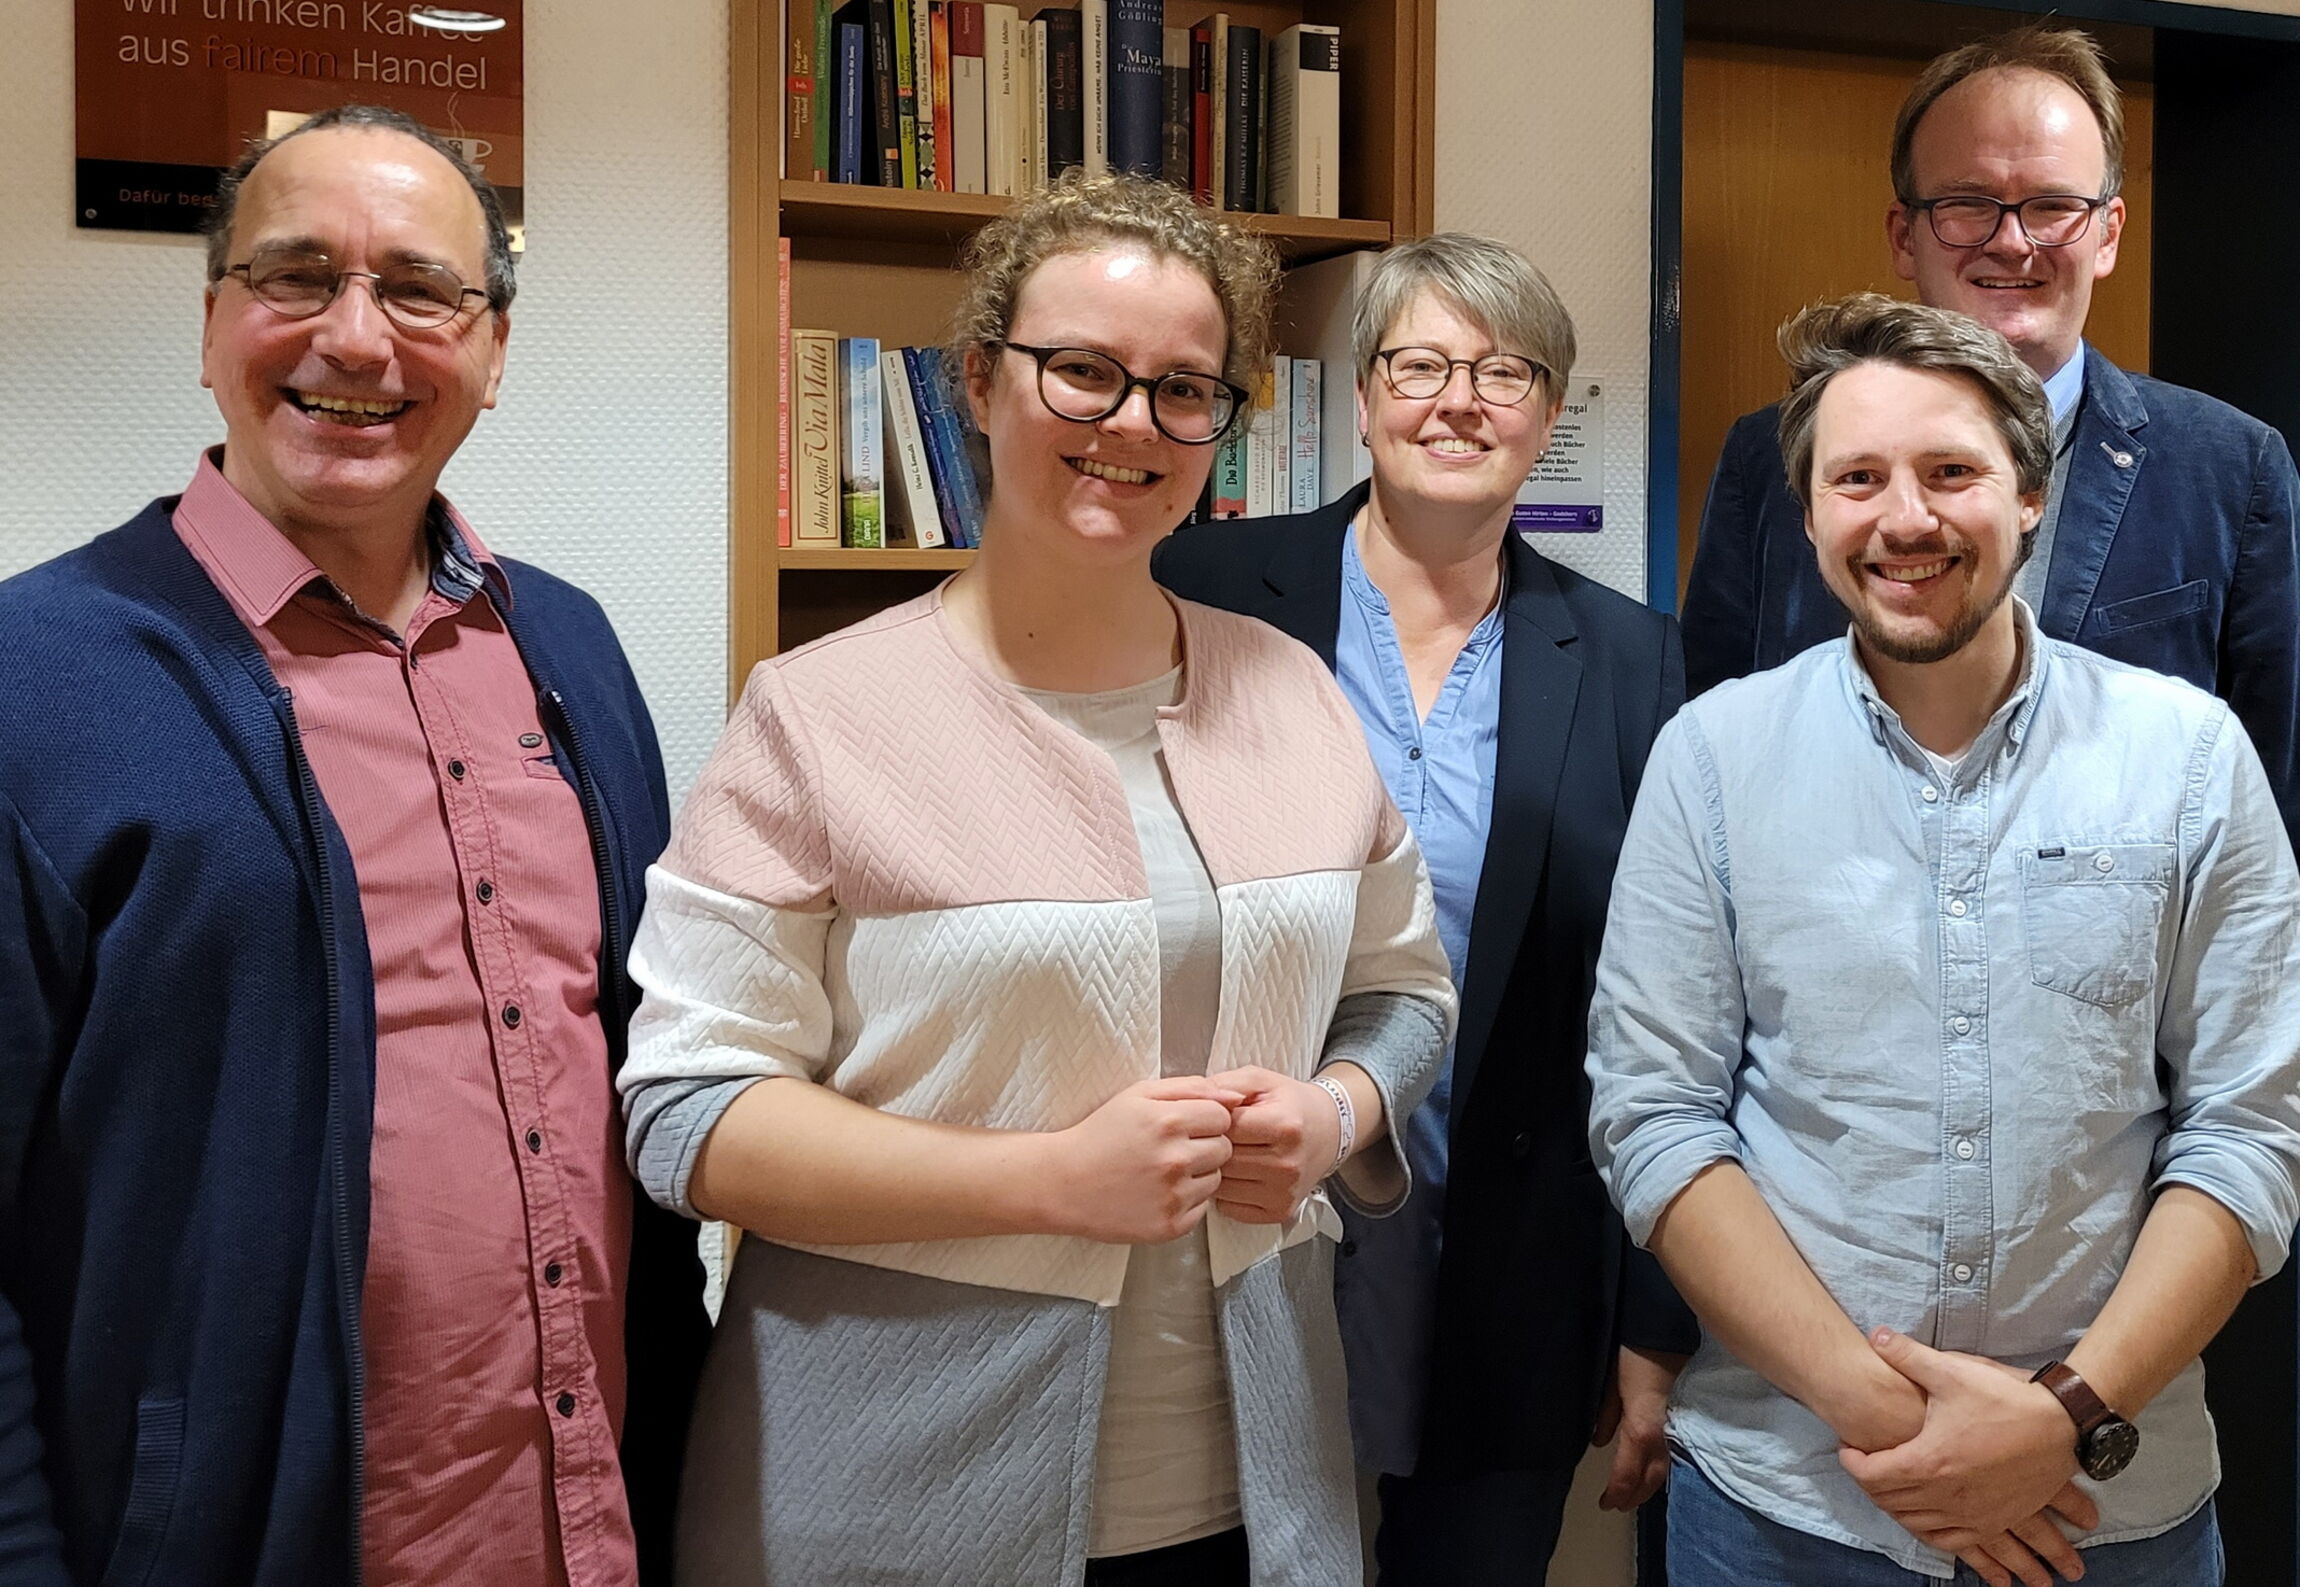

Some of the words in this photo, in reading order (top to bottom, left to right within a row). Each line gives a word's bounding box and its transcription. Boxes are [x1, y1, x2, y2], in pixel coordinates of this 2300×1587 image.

[203, 0, 346, 31] trinken
[917, 13, 926, 37] APRIL
[118, 34, 191, 67] aus
[201, 33, 339, 79] fairem
[353, 47, 487, 91] Handel
[1126, 48, 1162, 70] Maya
[1328, 36, 1340, 71] PIPER
[1240, 93, 1250, 107] DIE
[1240, 159, 1250, 194] THOMAS
[118, 188, 172, 205] Dafür
[802, 343, 829, 408] Mala
[1562, 403, 1587, 416] regal
[803, 409, 829, 458] Via
[1296, 431, 1318, 461] Hello
[861, 446, 871, 472] LIND
[812, 455, 834, 501] Knittel
[1225, 469, 1238, 486] Die
[1306, 469, 1315, 491] DAVE
[1297, 478, 1307, 507] LAURA
[813, 501, 830, 535] John
